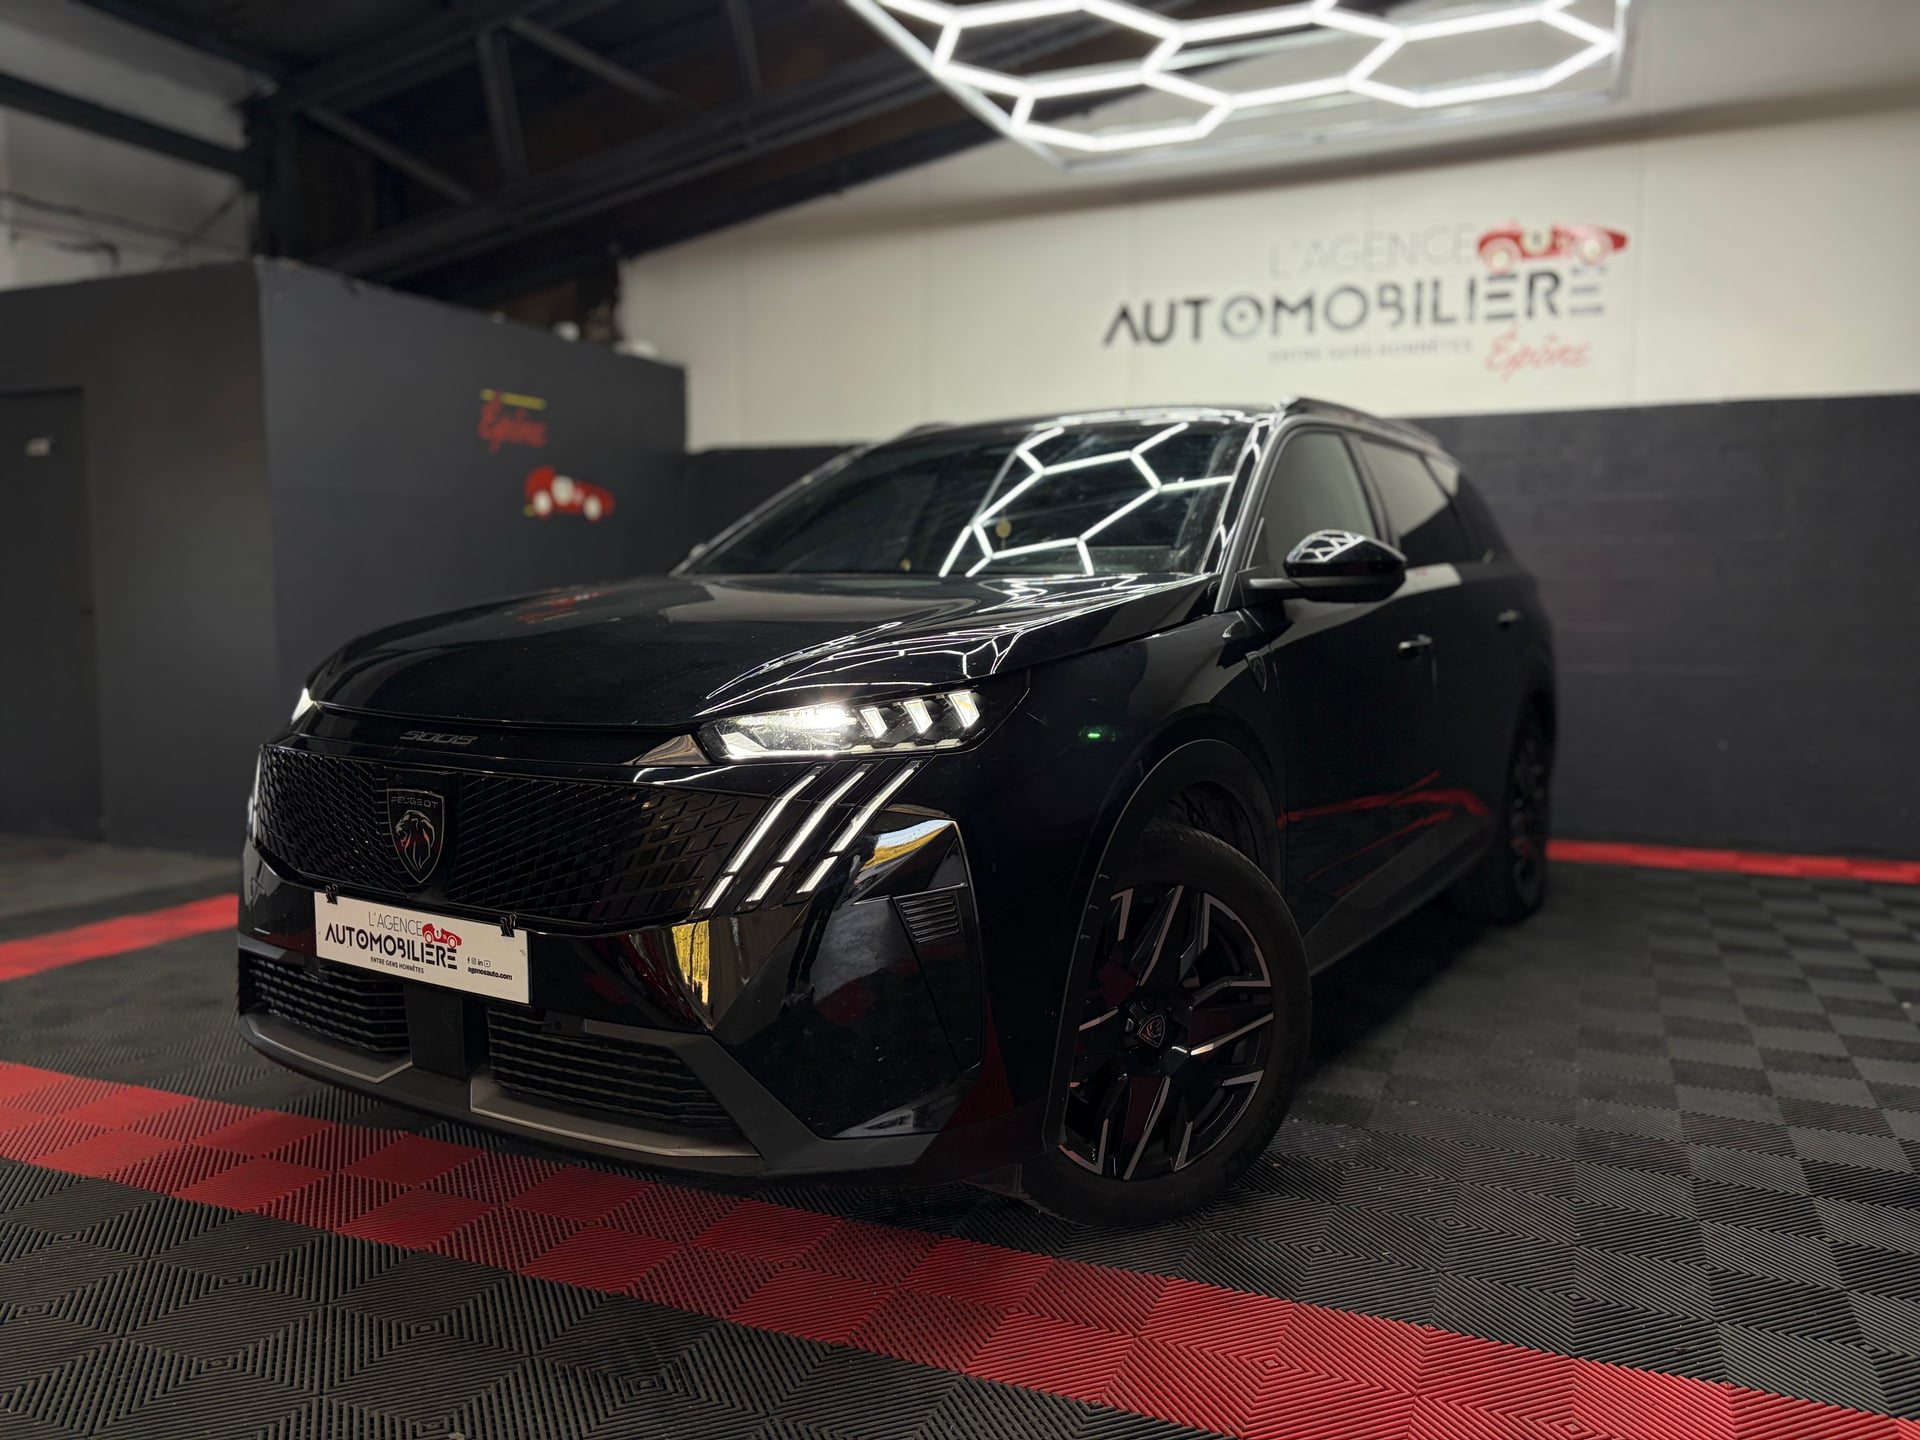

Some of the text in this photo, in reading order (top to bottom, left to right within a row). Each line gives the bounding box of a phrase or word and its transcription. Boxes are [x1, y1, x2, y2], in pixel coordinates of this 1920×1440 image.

[1268, 222, 1476, 280] L'AGENCE
[391, 796, 439, 809] PEUGEOT
[368, 911, 423, 937] L'AGENCE
